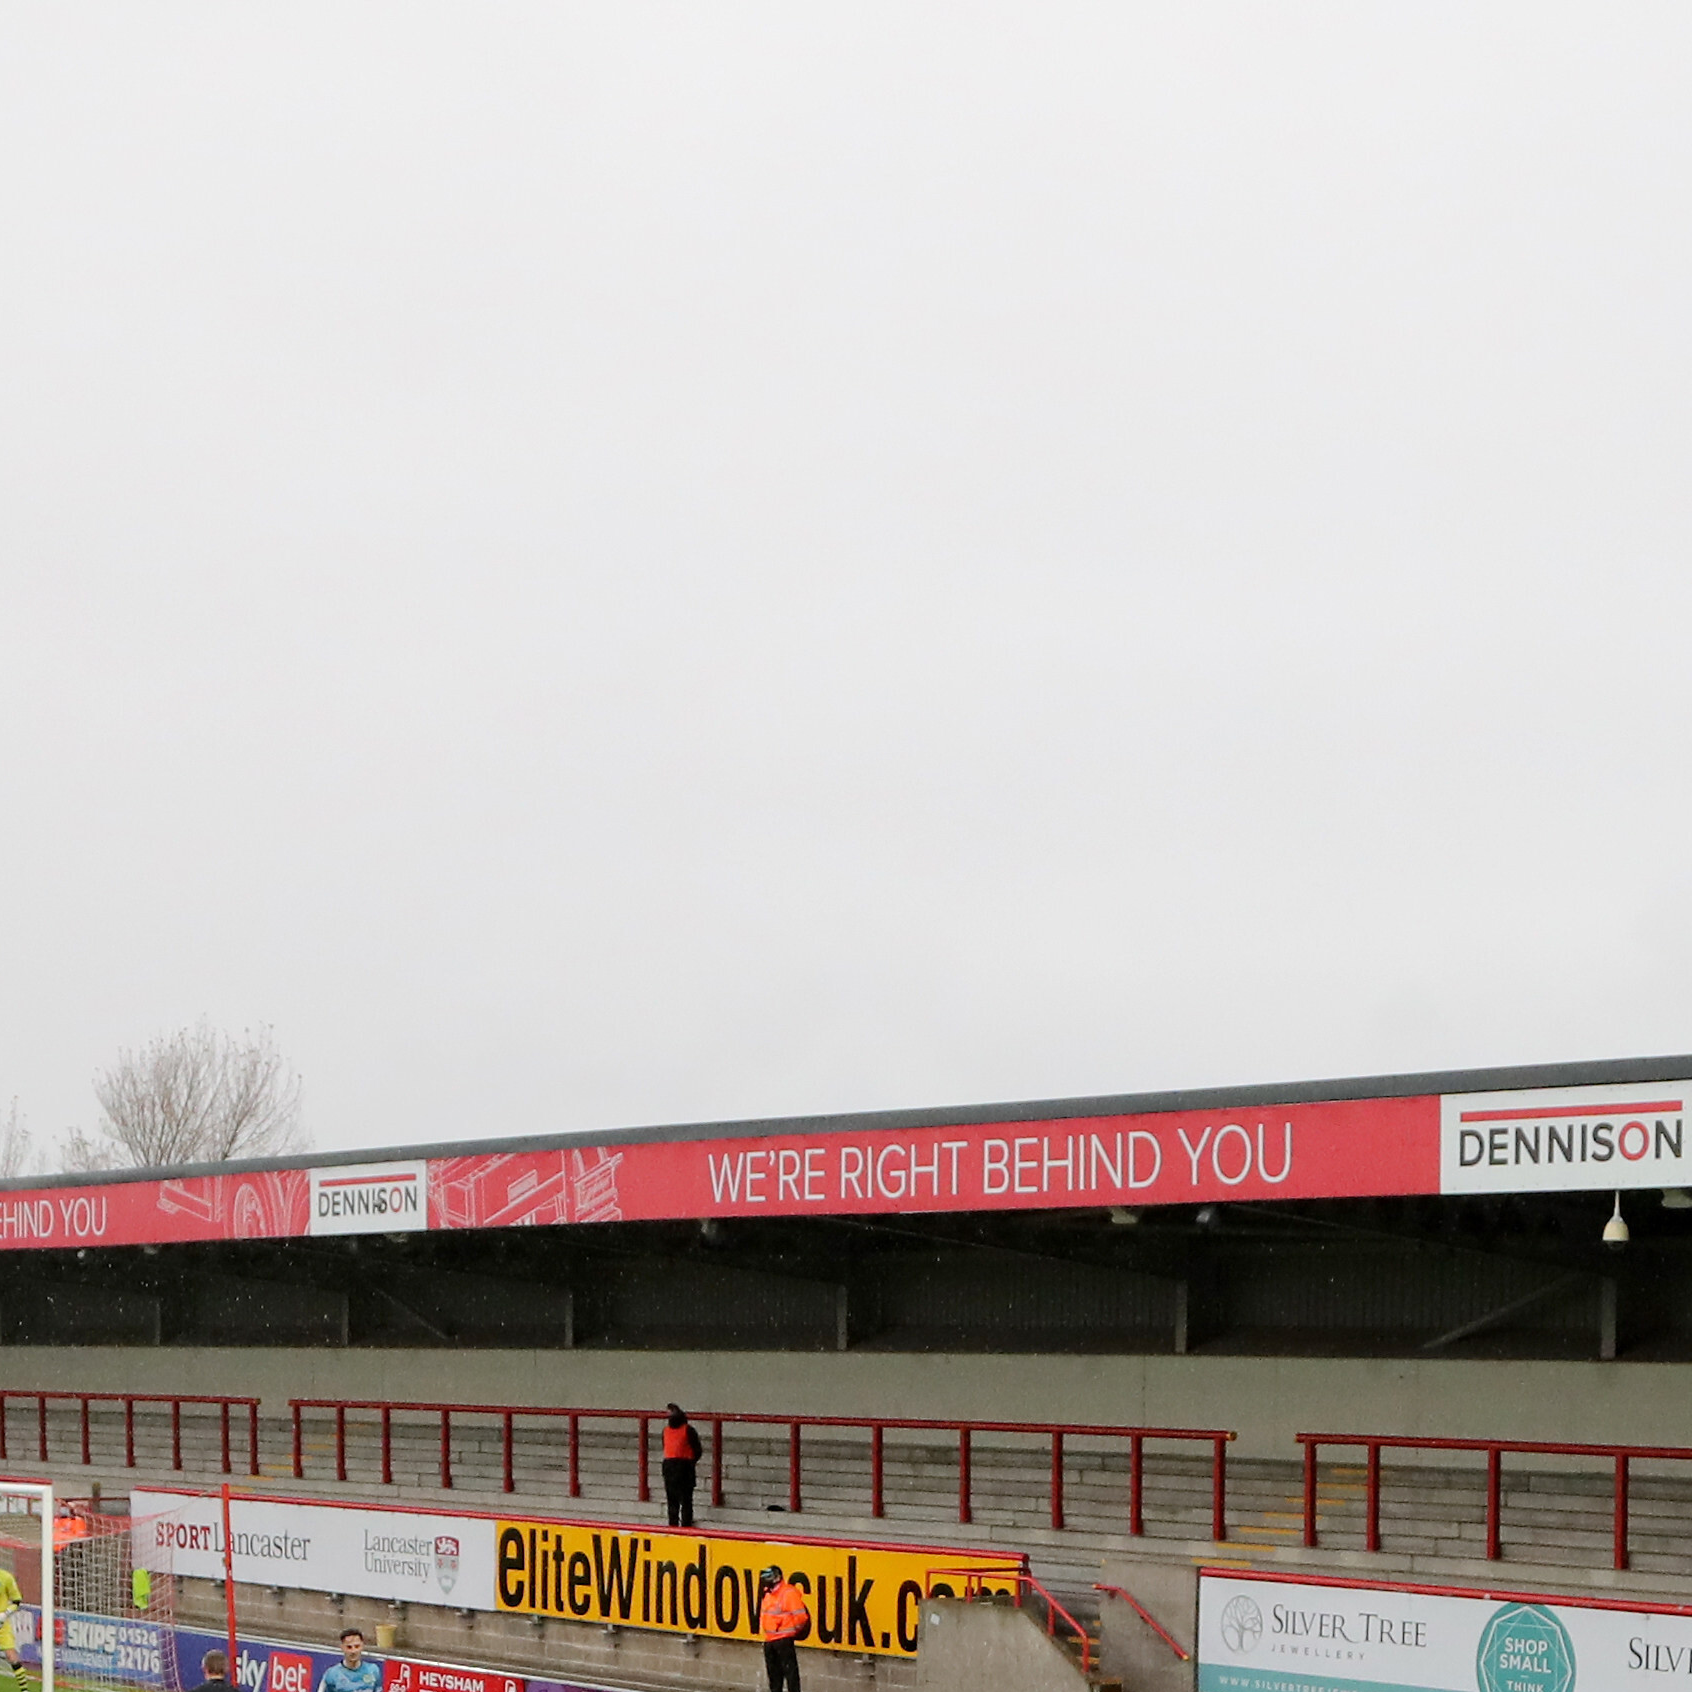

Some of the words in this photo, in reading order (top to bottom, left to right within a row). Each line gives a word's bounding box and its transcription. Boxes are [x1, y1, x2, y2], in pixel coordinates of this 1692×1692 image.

[1459, 1118, 1685, 1168] DENNISON
[707, 1147, 826, 1204] WE'RE
[839, 1140, 970, 1200] RIGHT
[983, 1130, 1163, 1194] BEHIND
[1176, 1121, 1293, 1186] YOU
[318, 1183, 418, 1217] DENNISON
[61, 1196, 108, 1236] YOU
[156, 1522, 211, 1551] SPORT
[364, 1529, 433, 1557] Lancaster
[364, 1552, 430, 1580] University
[68, 1620, 116, 1653] SKIPS
[1272, 1603, 1354, 1644] SILVER
[1359, 1612, 1428, 1648] TREE
[1271, 1644, 1366, 1661] JEWELLERY
[1505, 1637, 1548, 1655] SHOP
[1499, 1654, 1552, 1674] SMALL
